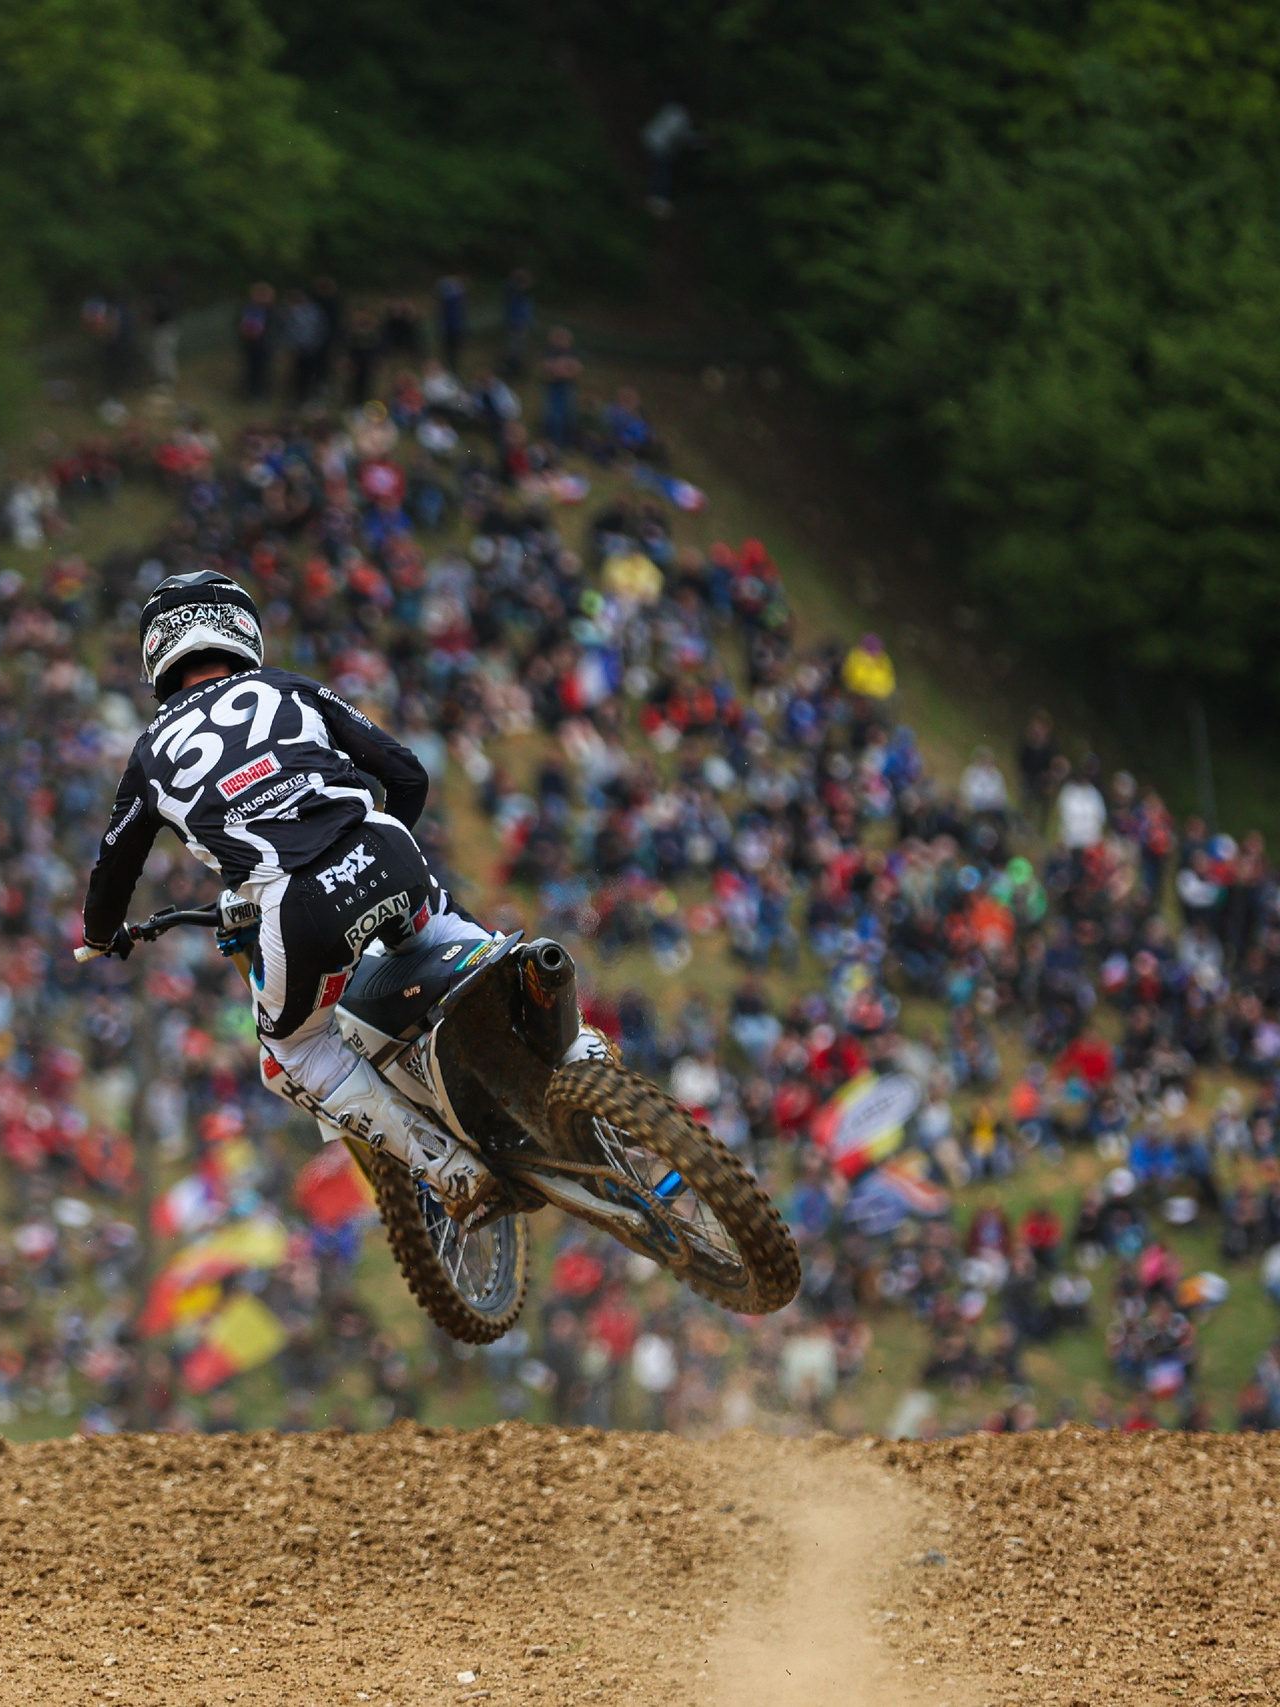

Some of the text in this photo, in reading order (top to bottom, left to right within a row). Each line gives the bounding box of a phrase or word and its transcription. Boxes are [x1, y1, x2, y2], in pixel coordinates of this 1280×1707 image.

[169, 608, 222, 628] ROAN
[238, 616, 253, 633] BELL
[147, 633, 159, 651] BELL
[151, 680, 282, 789] 39
[220, 758, 276, 797] nestaan
[240, 772, 307, 817] Husqvarna
[112, 796, 141, 837] Husqvarna
[316, 843, 376, 895] FOX
[336, 870, 389, 912] IMAGE
[346, 892, 409, 948] ROAN
